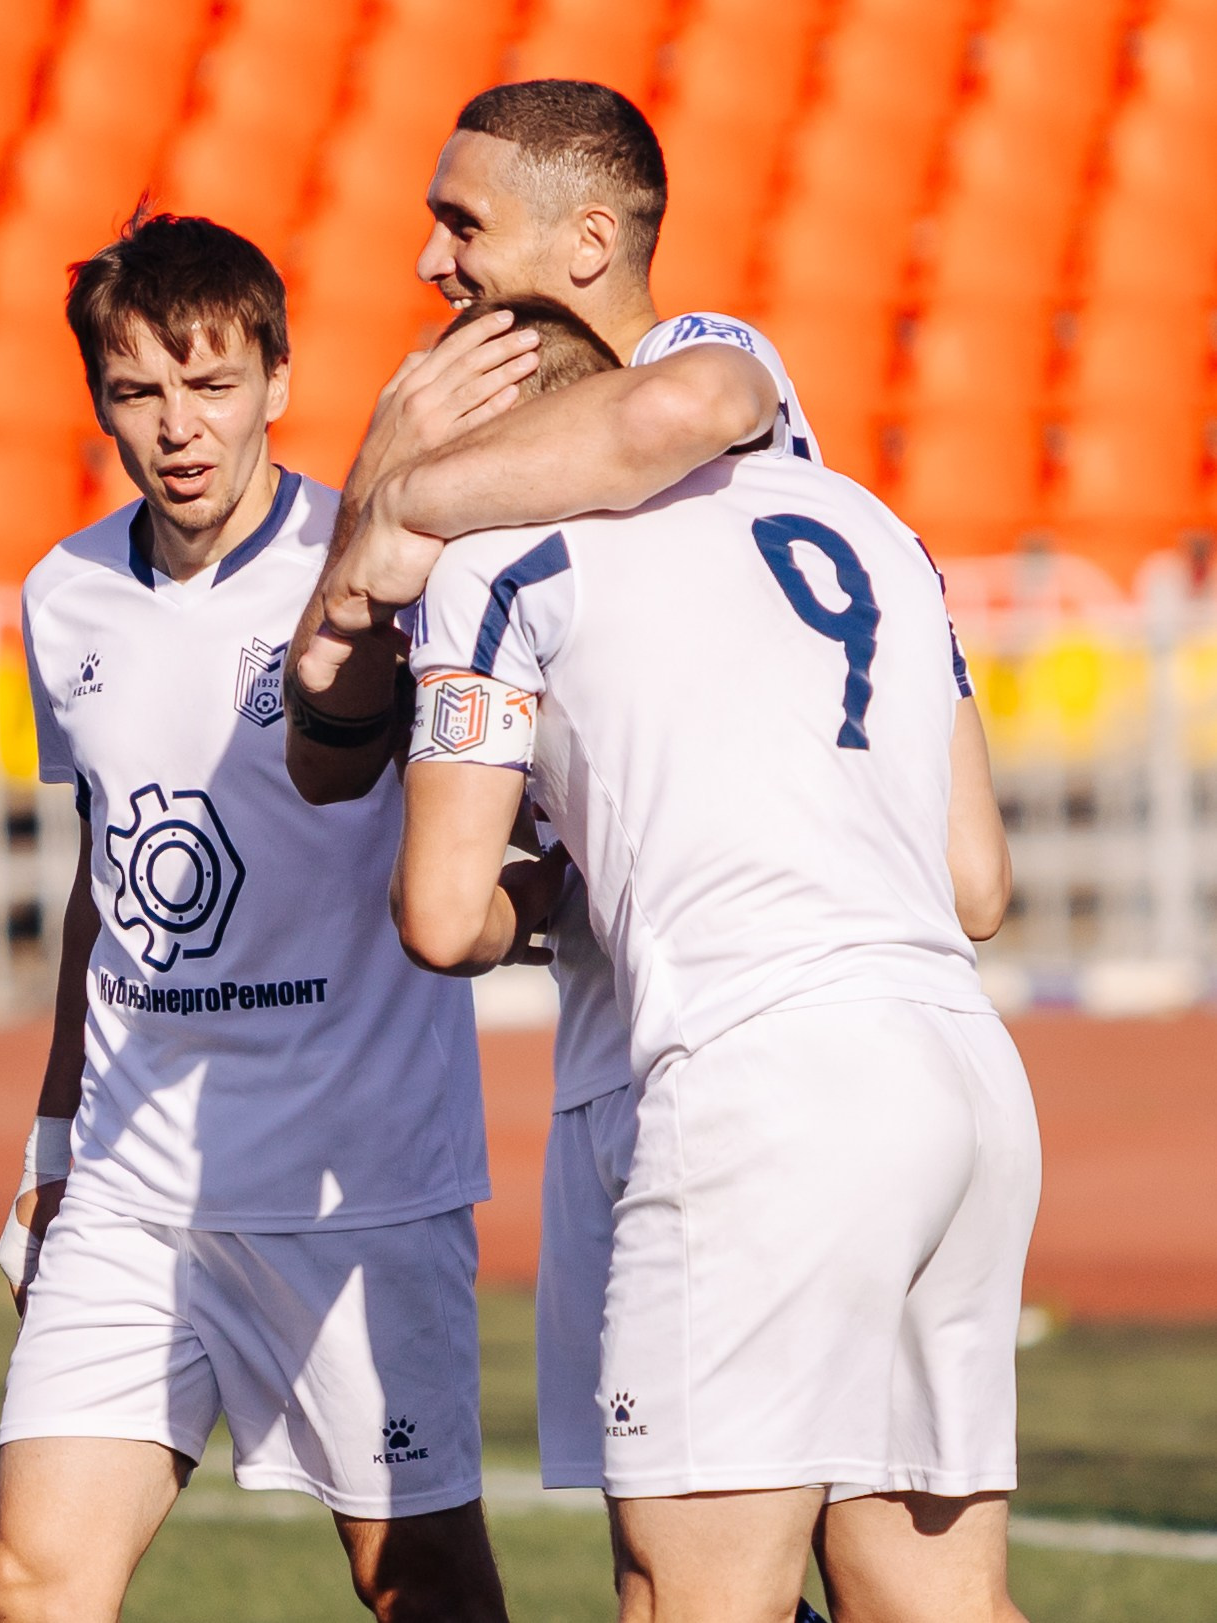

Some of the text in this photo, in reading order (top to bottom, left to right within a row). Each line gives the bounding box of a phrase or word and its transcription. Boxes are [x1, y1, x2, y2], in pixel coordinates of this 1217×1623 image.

[752, 513, 881, 751] 9
[256, 678, 281, 688] 1932
[502, 713, 514, 730] 9
[605, 1424, 649, 1437] KELME
[373, 1447, 429, 1464] KELME
